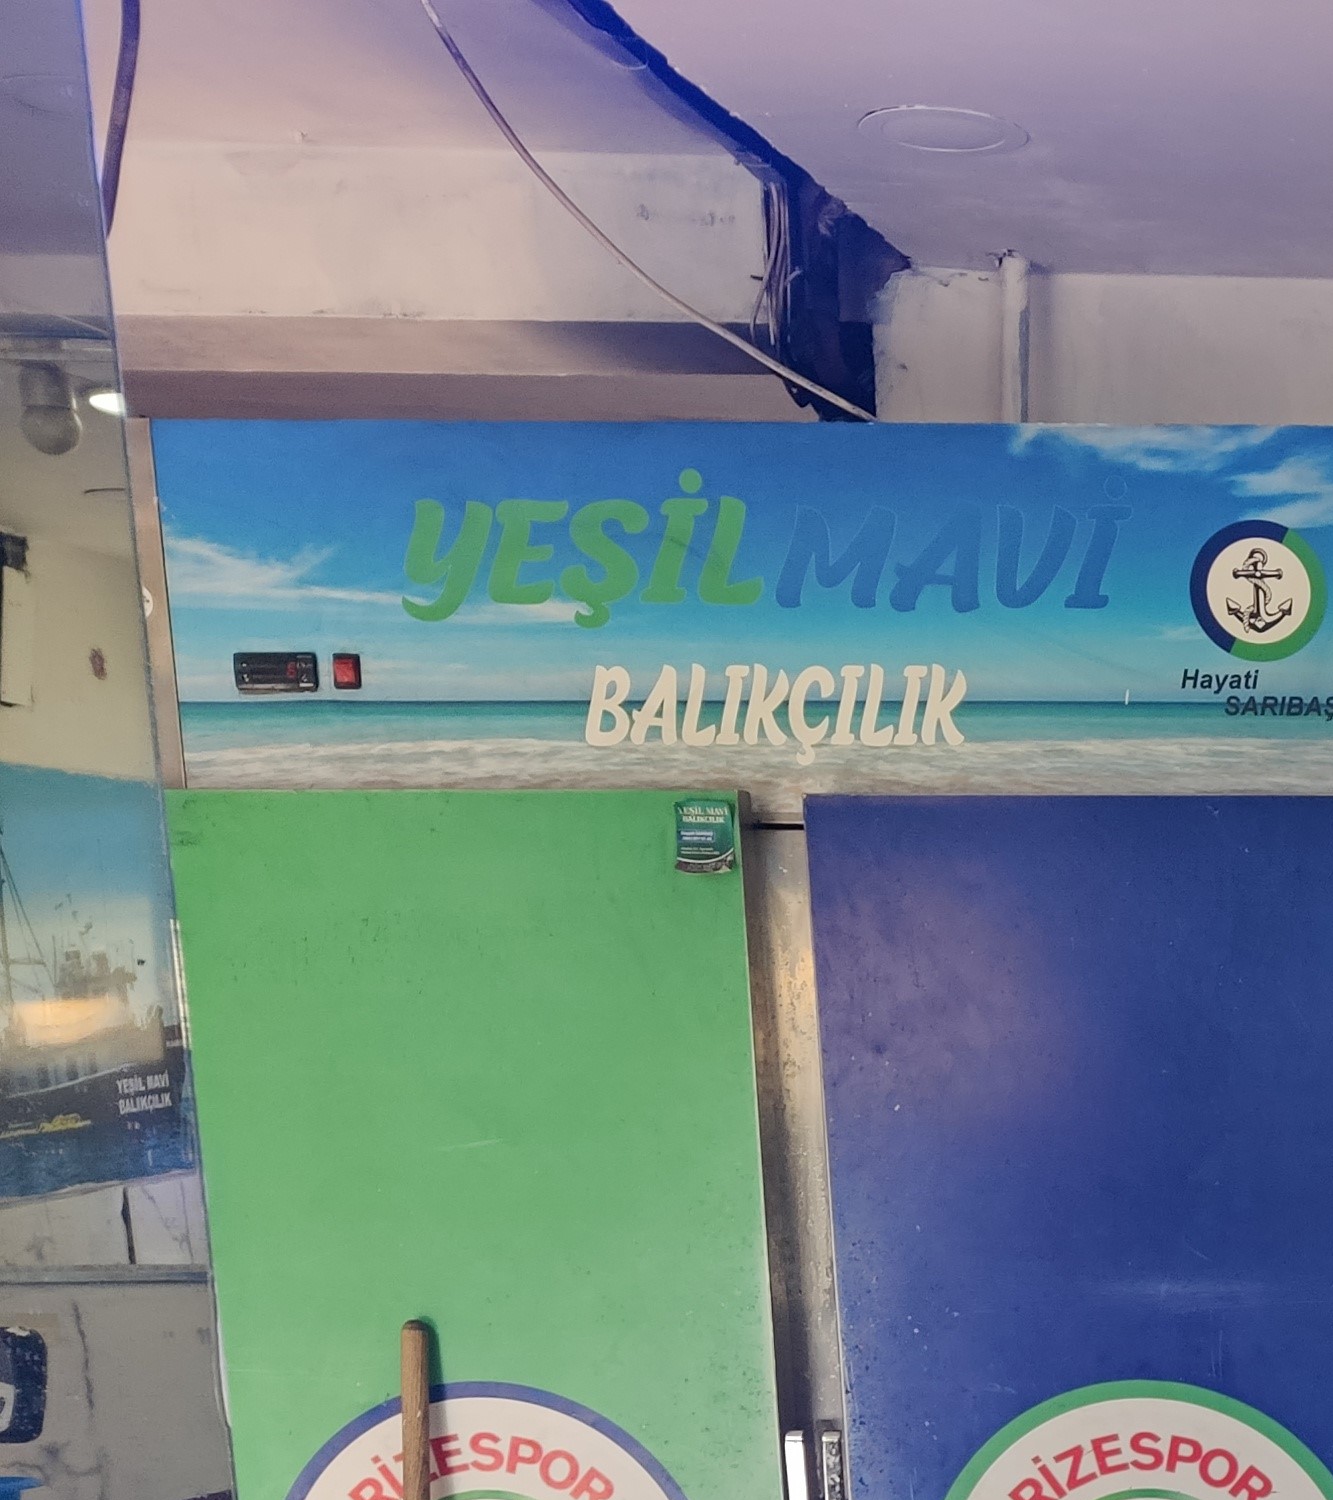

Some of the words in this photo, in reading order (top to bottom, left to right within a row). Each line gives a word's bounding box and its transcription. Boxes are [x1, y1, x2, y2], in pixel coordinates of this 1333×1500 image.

[402, 468, 765, 628] YEŞİL
[775, 475, 1134, 612] MAVİ
[585, 663, 967, 766] BALIKÇILIK
[1181, 668, 1259, 694] Hayati
